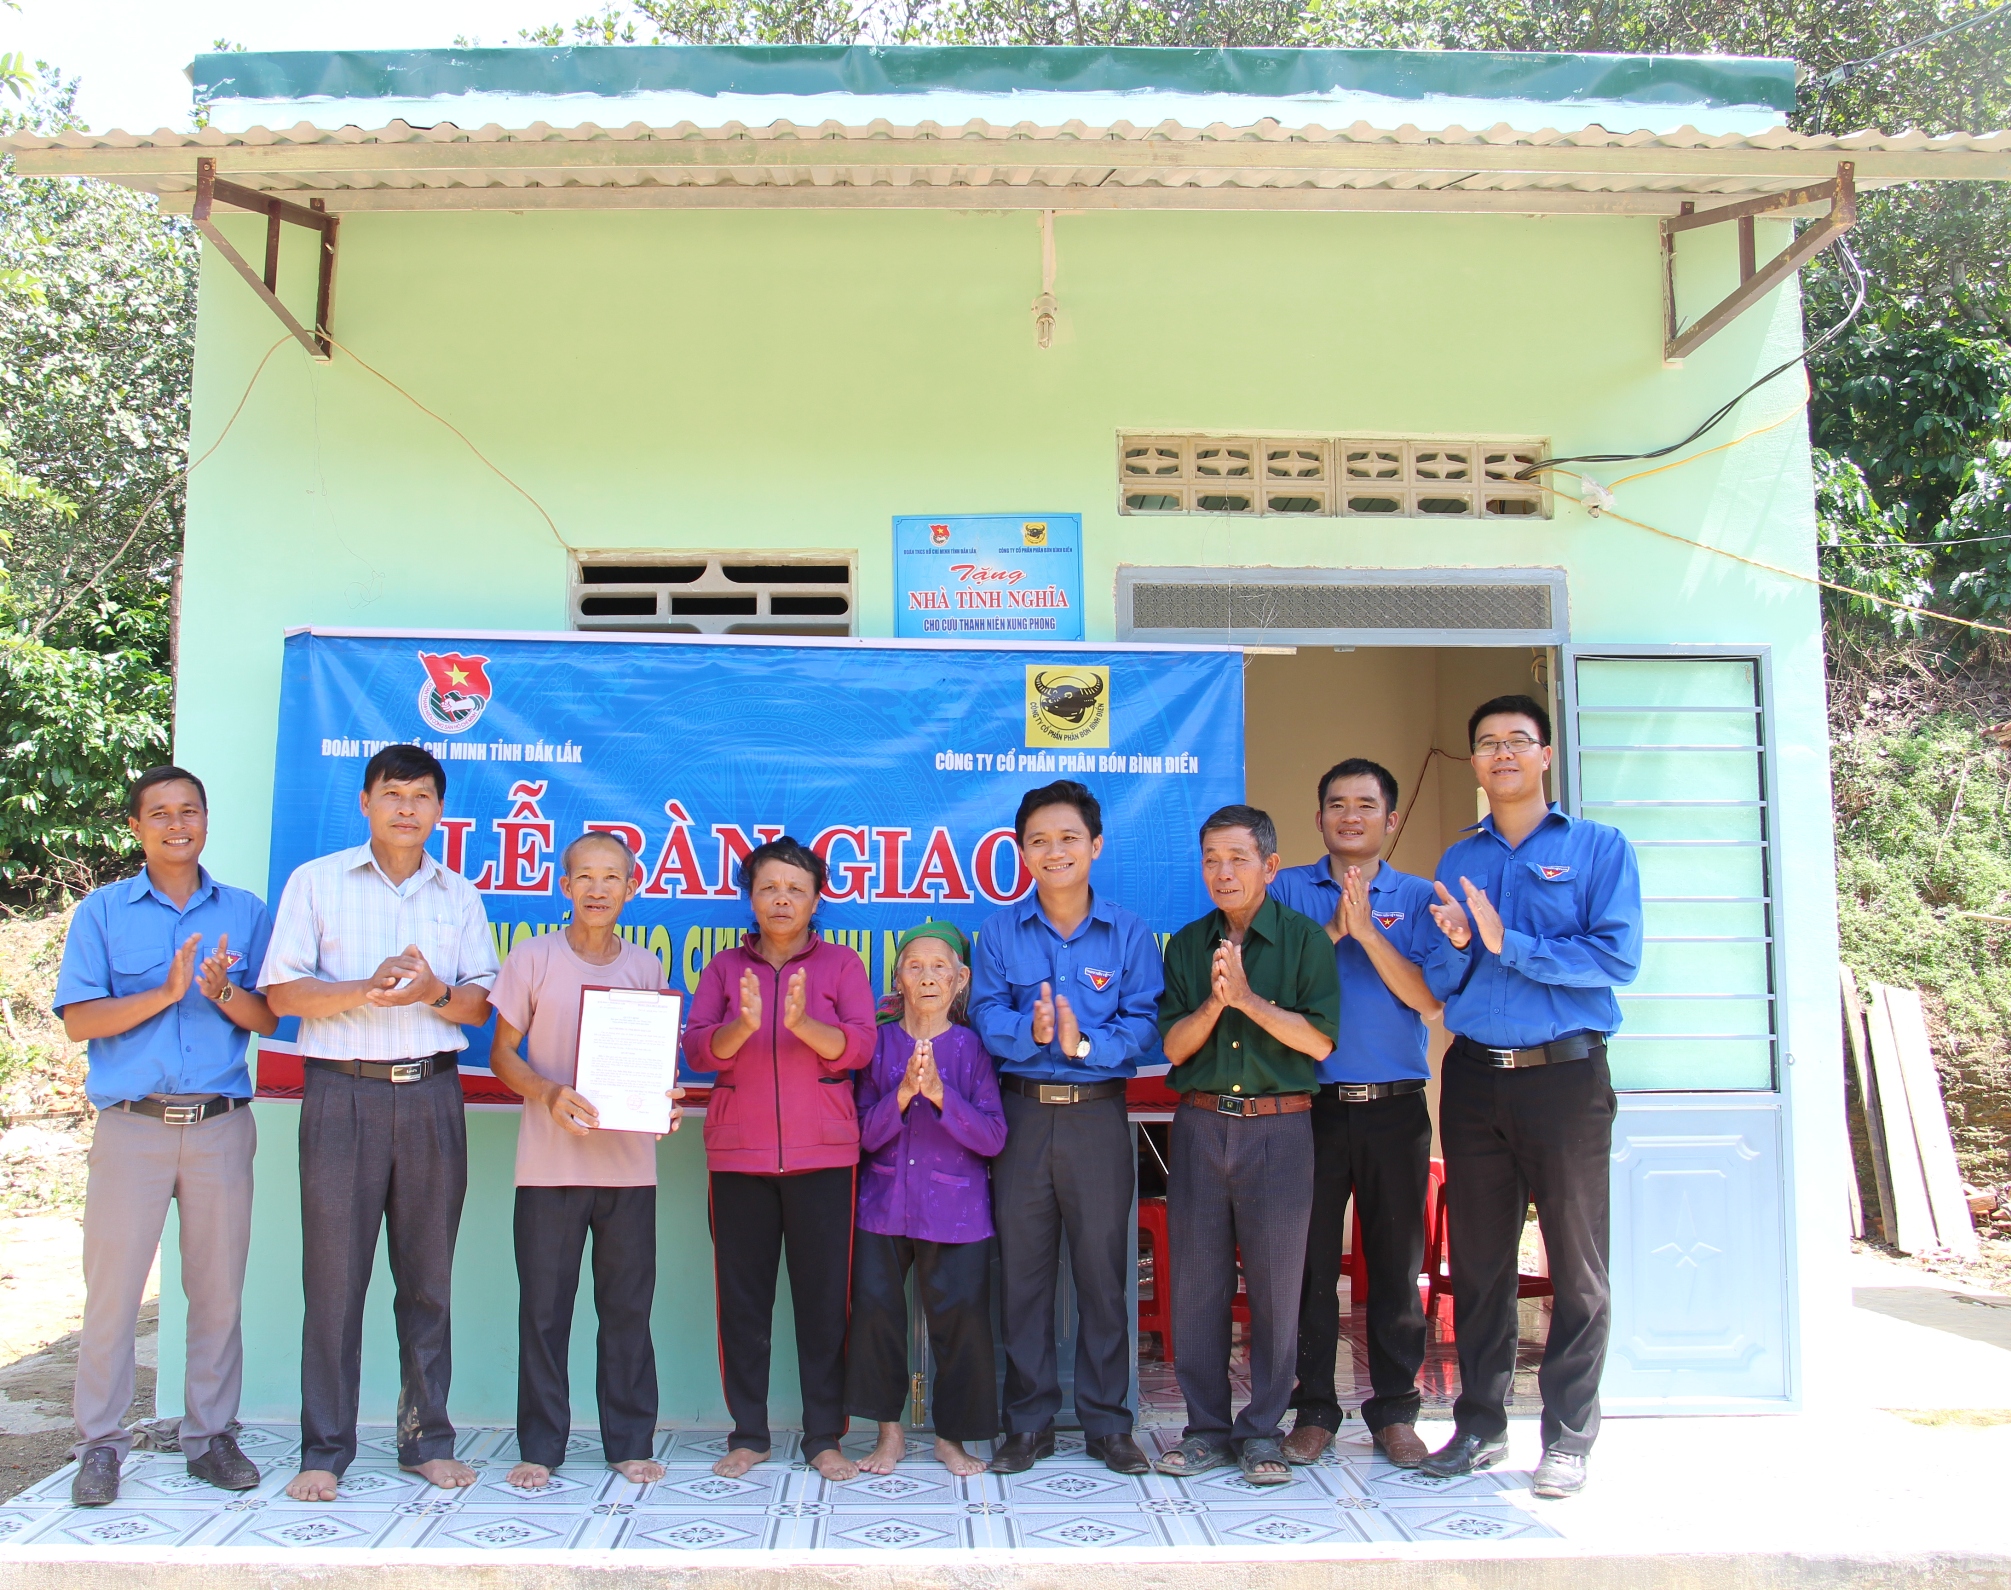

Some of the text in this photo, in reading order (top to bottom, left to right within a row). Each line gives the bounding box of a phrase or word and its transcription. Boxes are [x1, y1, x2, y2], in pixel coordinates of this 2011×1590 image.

[950, 564, 1026, 585] Tặng
[909, 585, 1068, 609] NHÀ TÌNH NGHĨA
[924, 616, 1056, 634] CHO CỰU THANH NIÊN XUNG PHONG
[1035, 717, 1043, 726] TY
[321, 735, 360, 757] ĐOÀN
[362, 740, 399, 757] TN
[423, 739, 449, 760] CHÍ
[450, 742, 487, 761] MINH
[490, 738, 522, 762] TỈNH
[525, 739, 554, 763] ĐẮK
[556, 740, 583, 763] LẮK
[935, 747, 1198, 774] CÔNG TY CỔ PHẦN PHÂN BÓN BÌNH ĐIỀN
[436, 779, 555, 896] LỄ
[809, 824, 1037, 906] GIAO
